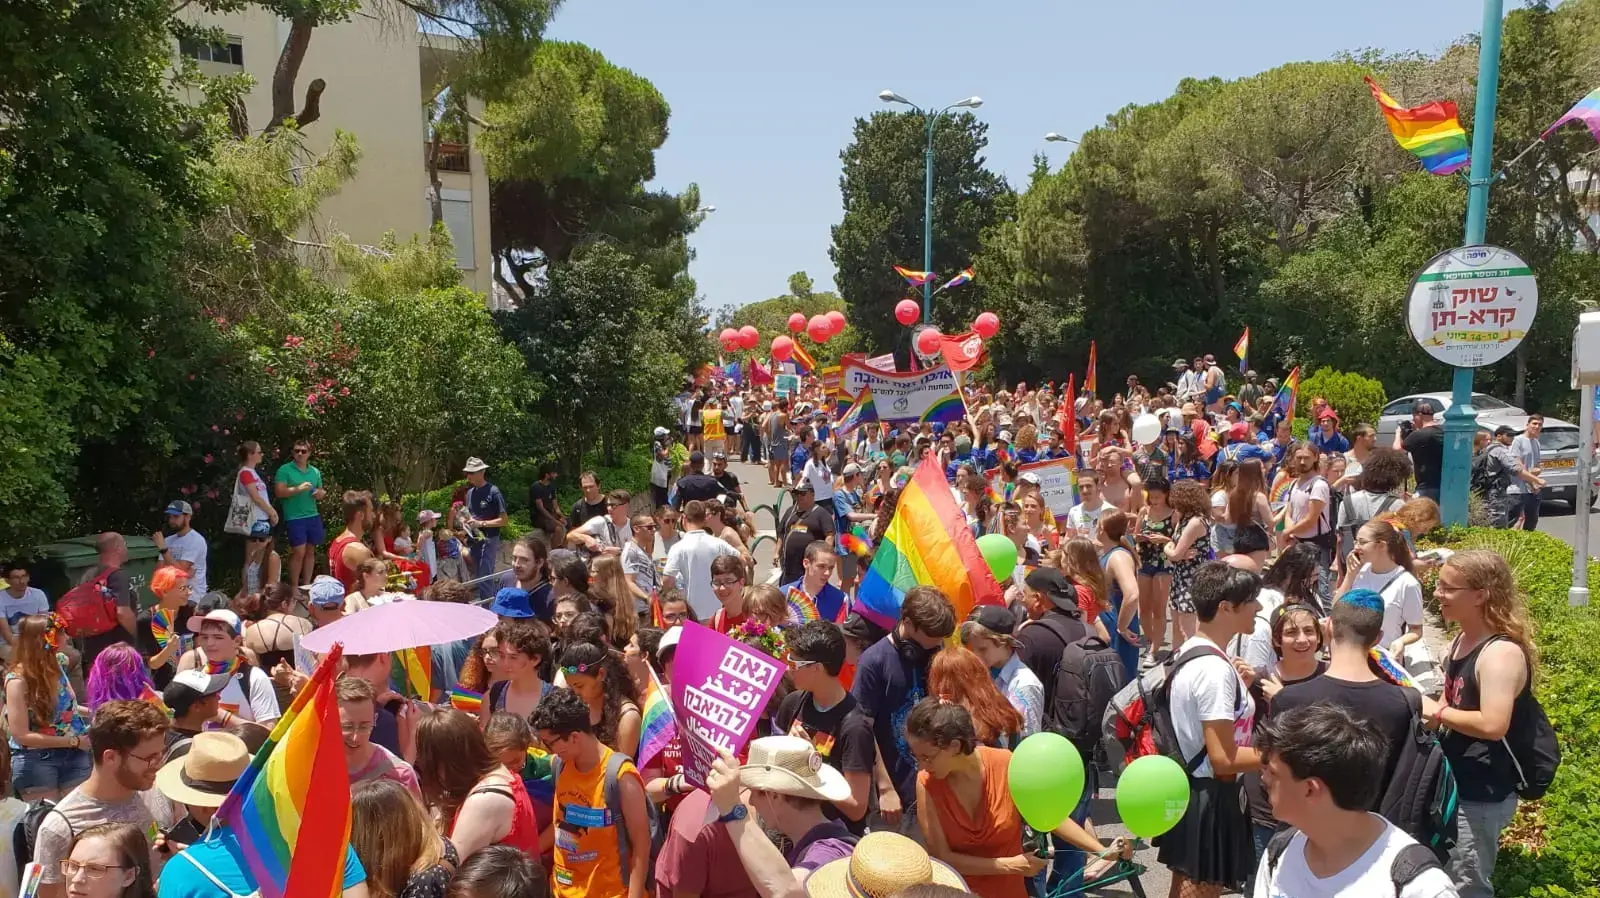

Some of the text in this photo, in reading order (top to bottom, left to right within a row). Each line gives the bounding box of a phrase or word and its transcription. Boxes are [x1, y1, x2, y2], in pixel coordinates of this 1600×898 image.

[1452, 287, 1498, 308] שוק
[1432, 308, 1516, 331] קרא-תן
[723, 650, 773, 688] גאה
[700, 673, 761, 709] افتخر
[686, 690, 746, 732] להיאבק
